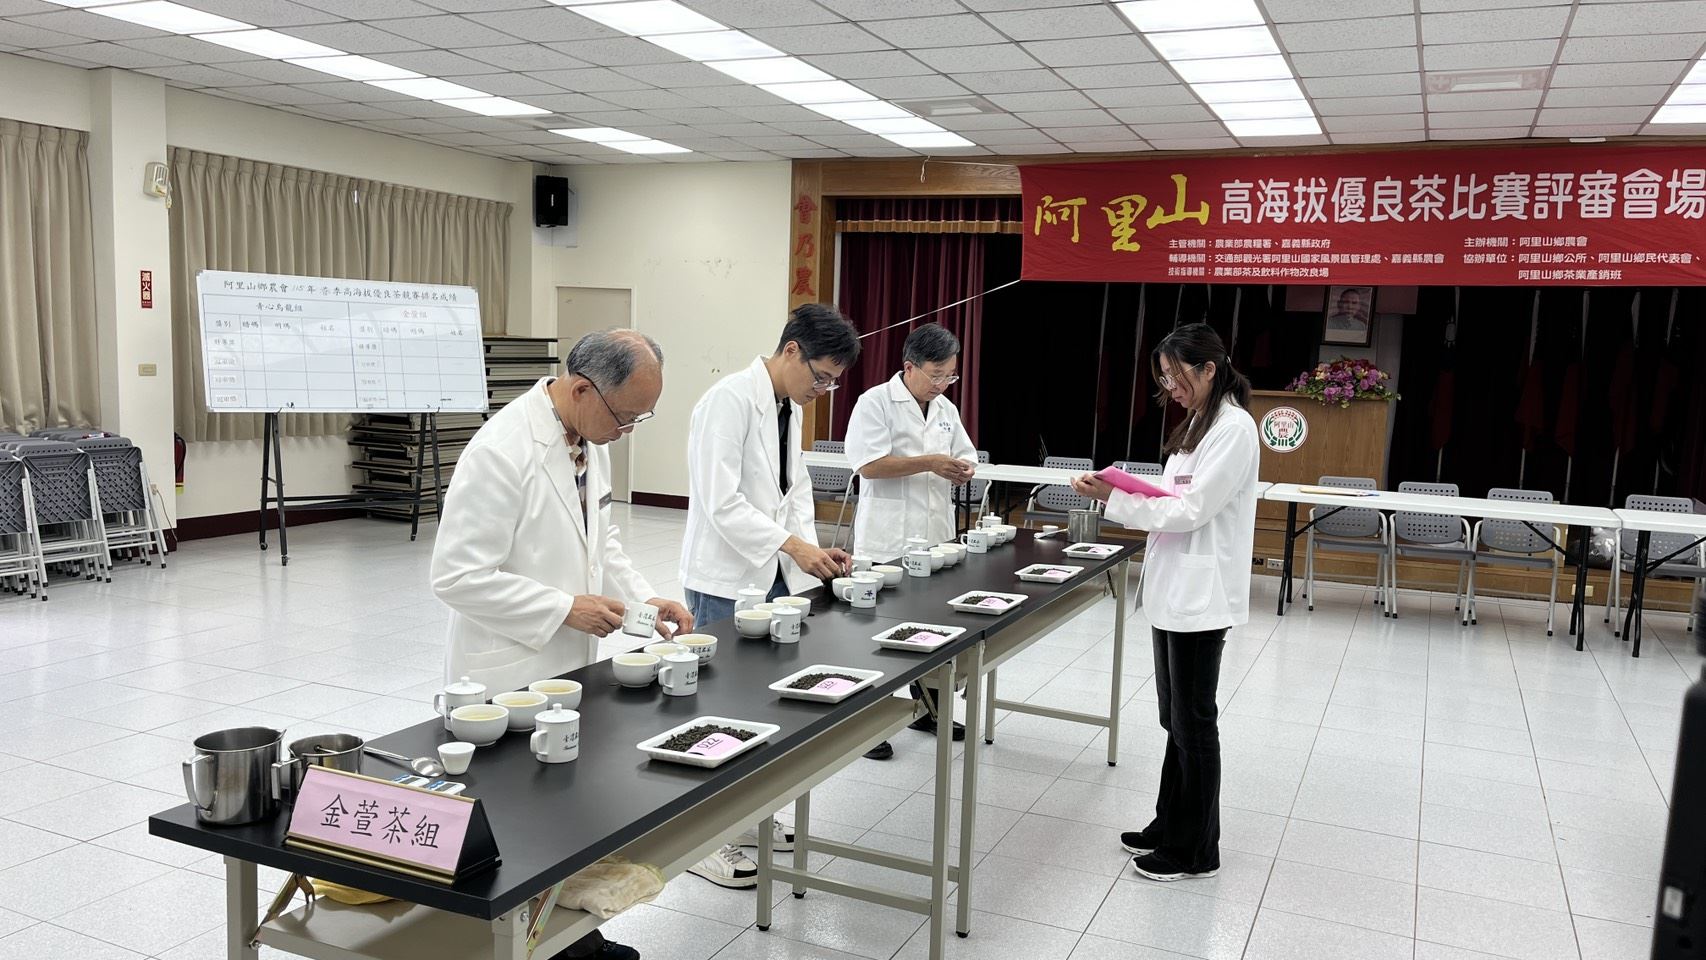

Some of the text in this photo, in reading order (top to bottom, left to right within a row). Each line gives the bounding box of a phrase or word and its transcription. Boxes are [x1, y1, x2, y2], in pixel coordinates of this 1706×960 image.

[1034, 167, 1706, 252] 阿里山 高海拔優良茶比賽評審會場
[1518, 269, 1622, 281] 阿里山鄉茶業產銷班
[320, 793, 440, 849] 金萱茶組
